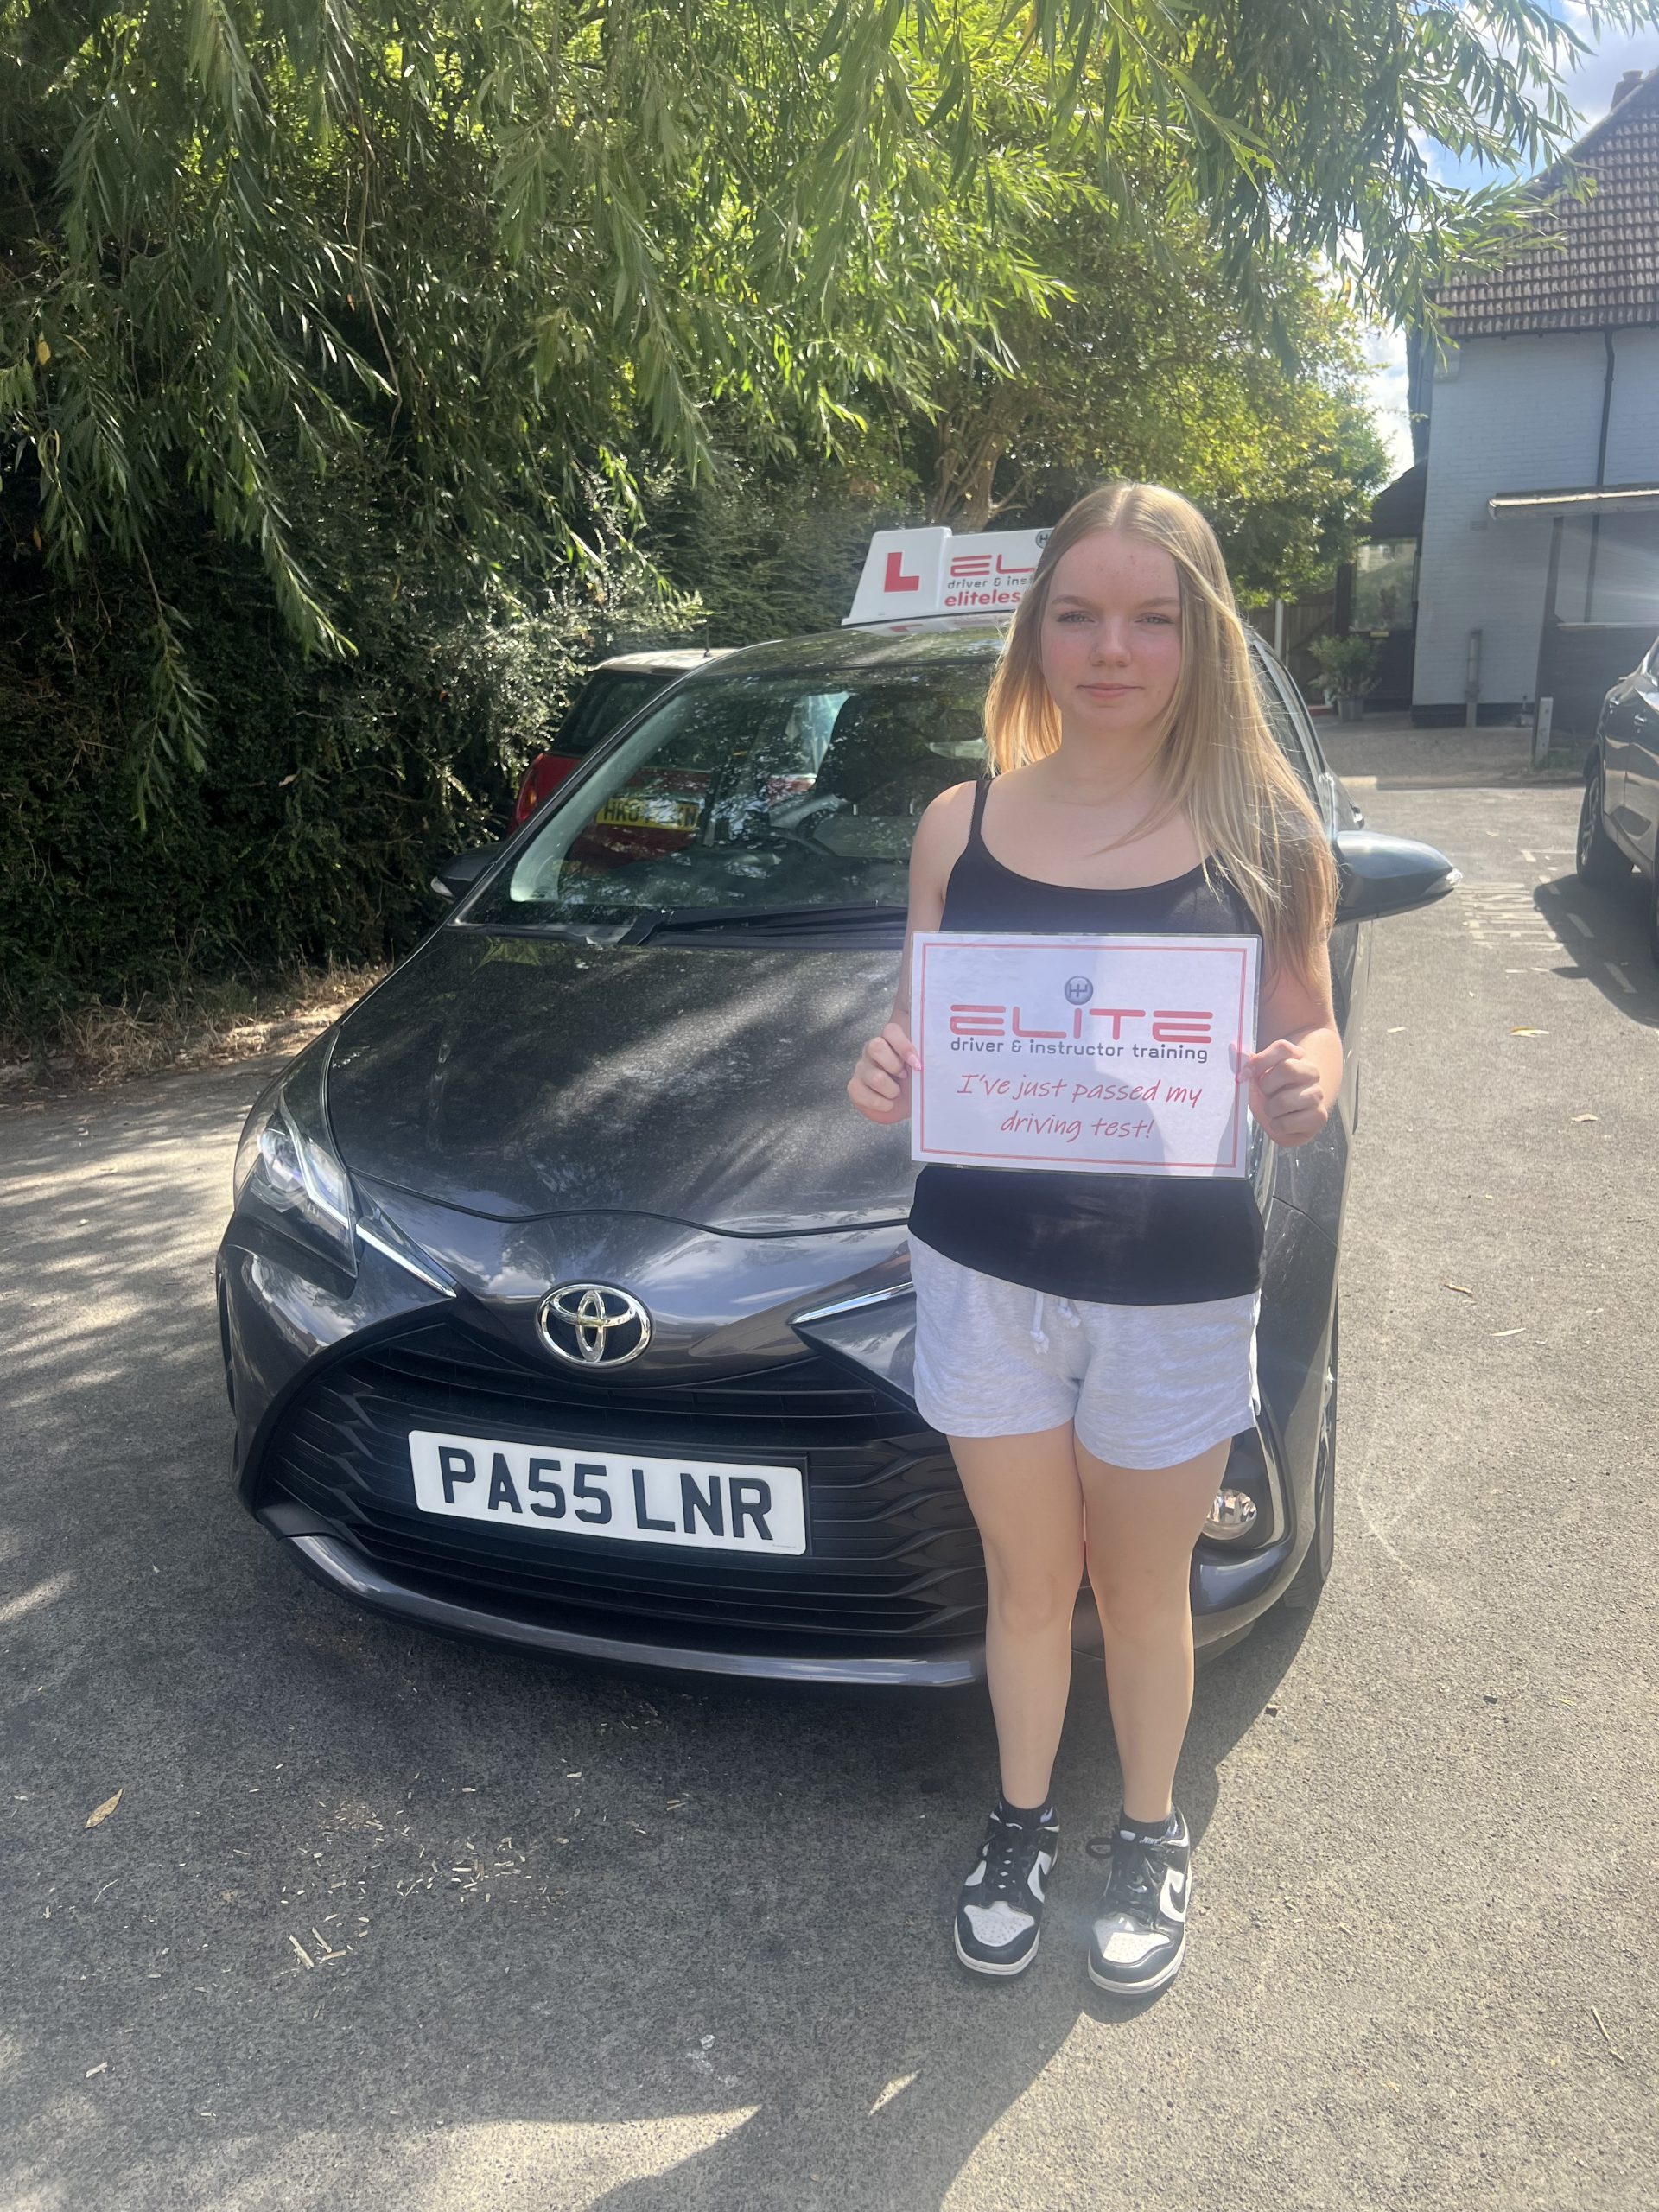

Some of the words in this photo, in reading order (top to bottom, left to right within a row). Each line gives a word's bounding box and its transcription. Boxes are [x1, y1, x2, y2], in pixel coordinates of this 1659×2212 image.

[884, 552, 919, 593] L
[950, 554, 1036, 577] EL
[944, 588, 1021, 607] eliteles
[947, 578, 988, 589] driver
[994, 577, 1002, 587] &
[1007, 575, 1033, 586] inst
[950, 1005, 1213, 1045] ELITE
[950, 1037, 1004, 1052] driver
[1011, 1039, 1022, 1053] &
[1029, 1039, 1125, 1058] instructor
[1132, 1043, 1208, 1064] training
[957, 1074, 1011, 1096] I've
[1012, 1075, 1068, 1102] just
[1071, 1079, 1162, 1103] passed
[1165, 1084, 1203, 1109] my
[1000, 1111, 1083, 1143] driving
[1090, 1117, 1155, 1140] test!
[438, 1446, 613, 1526] PA55
[632, 1468, 774, 1541] LNR
